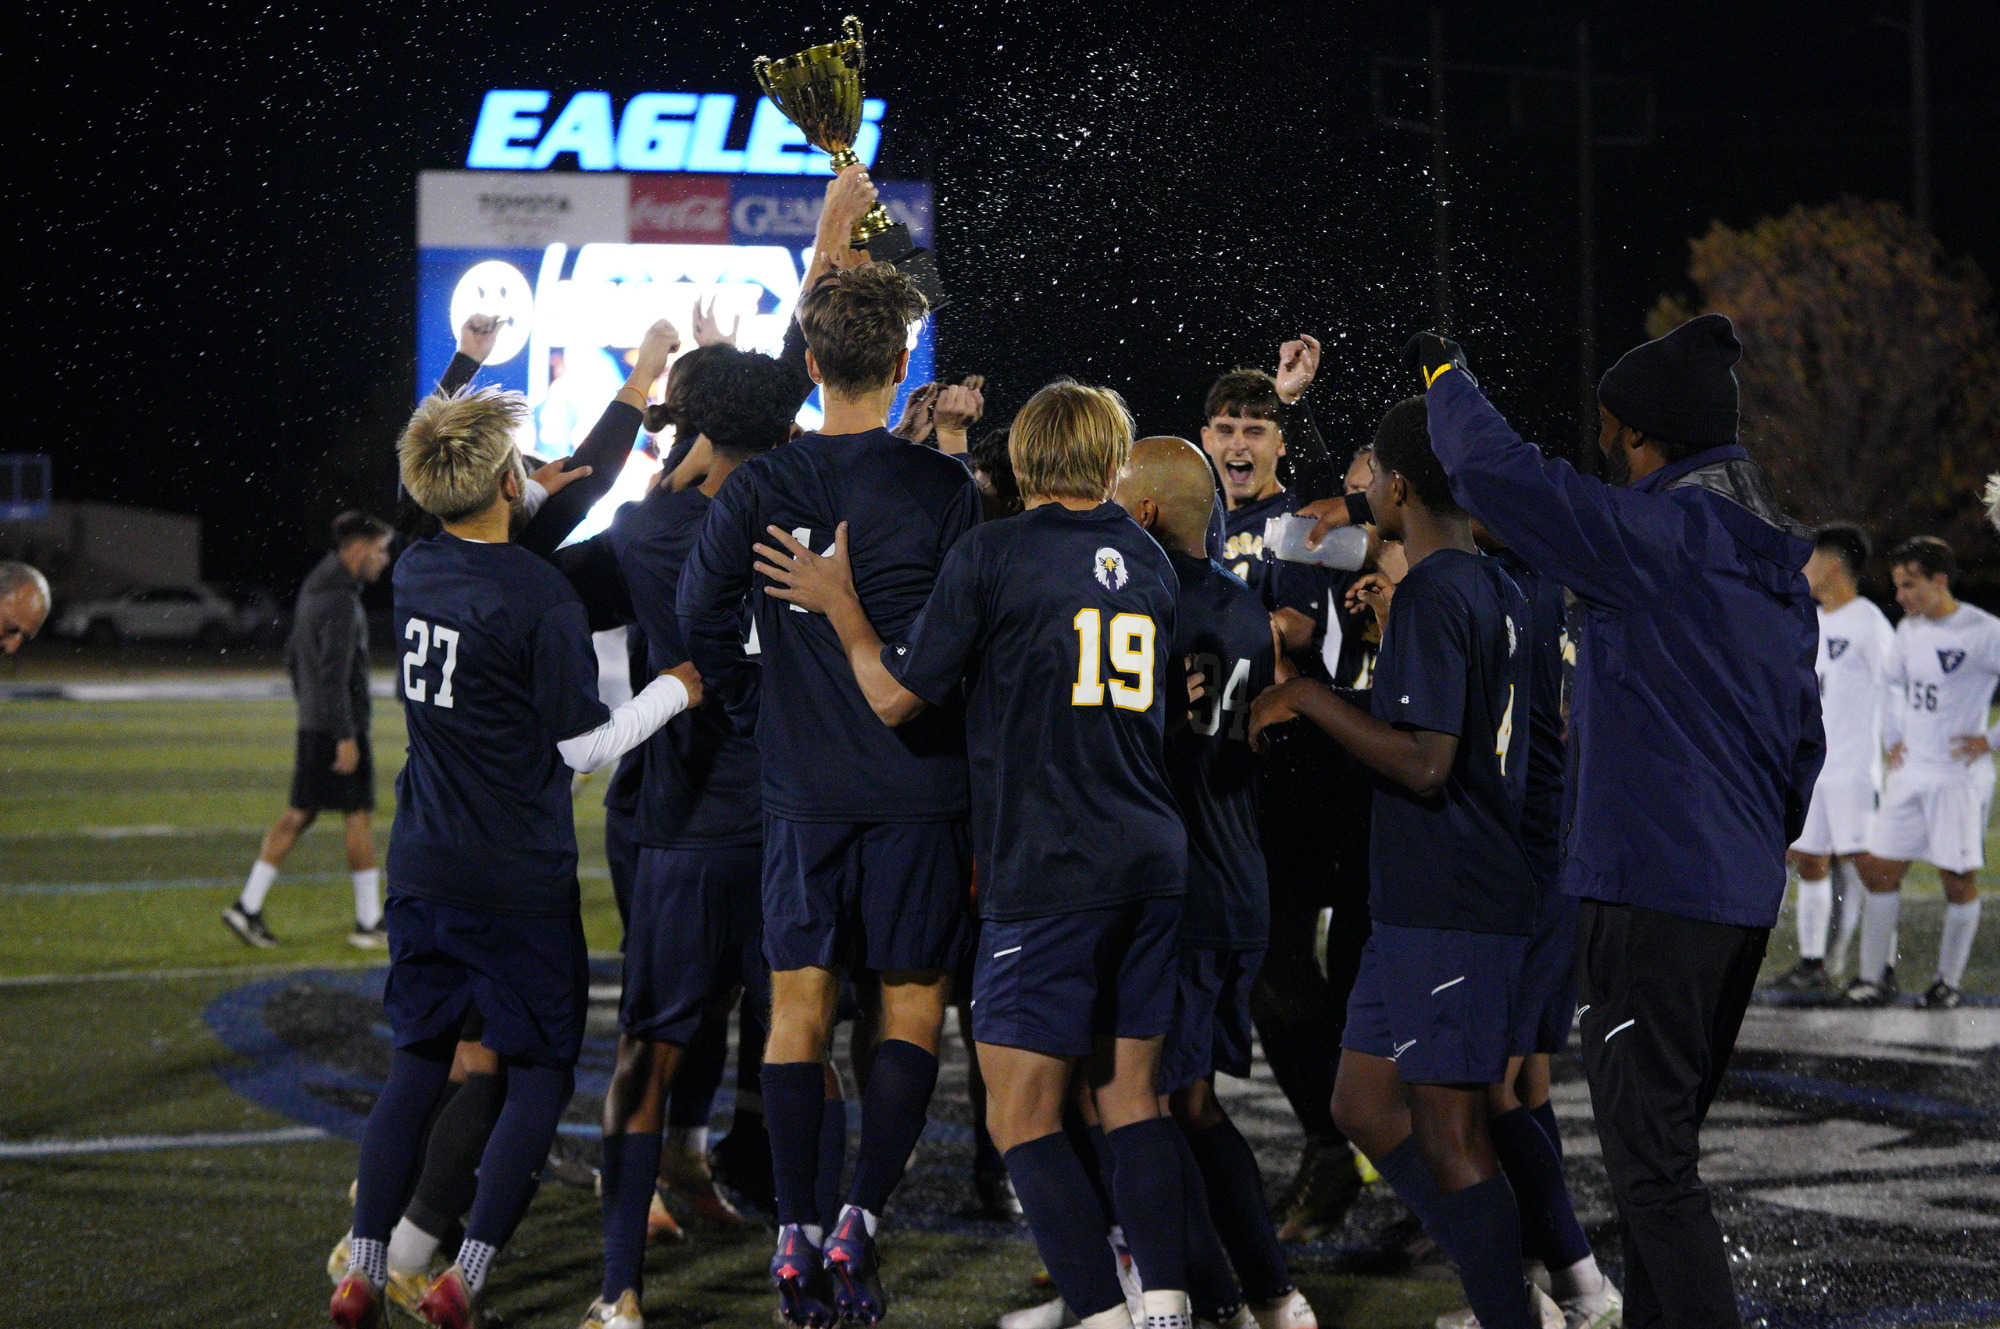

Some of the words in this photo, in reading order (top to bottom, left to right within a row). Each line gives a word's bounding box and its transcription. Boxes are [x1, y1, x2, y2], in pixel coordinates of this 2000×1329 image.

[466, 89, 887, 176] EAGLES
[403, 617, 460, 709] 27
[1072, 608, 1156, 712] 19
[1189, 652, 1251, 741] 34
[1912, 680, 1938, 712] 56
